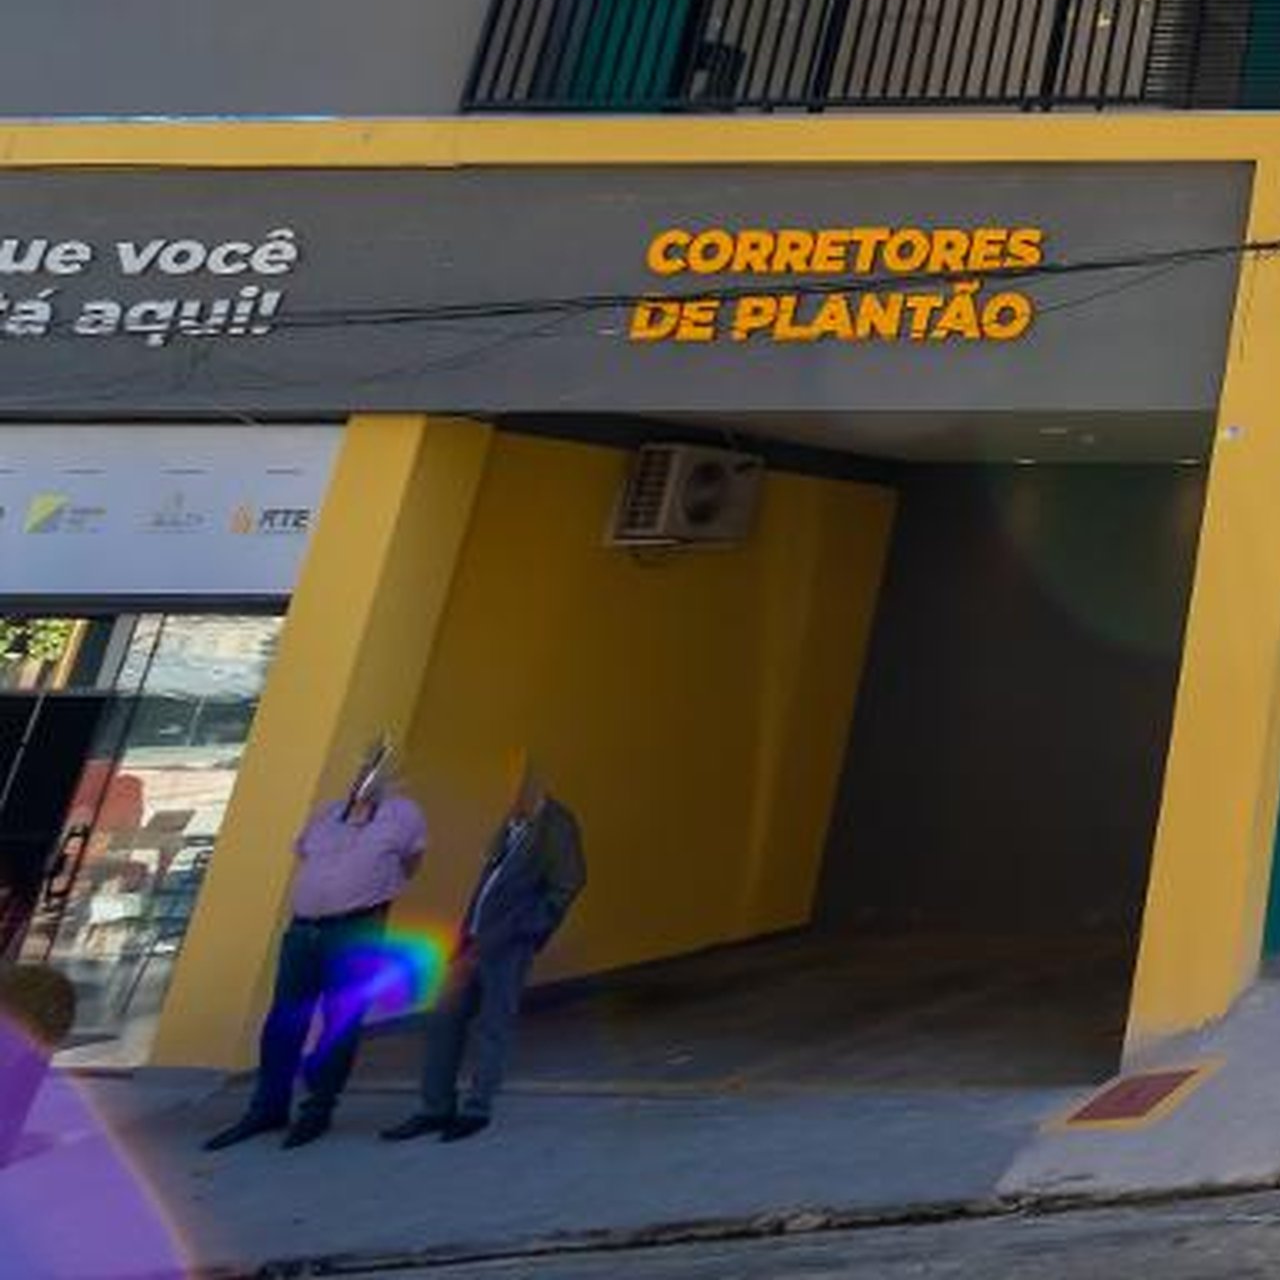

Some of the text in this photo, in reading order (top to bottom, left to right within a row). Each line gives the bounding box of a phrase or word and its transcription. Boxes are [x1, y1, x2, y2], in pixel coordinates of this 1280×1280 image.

[116, 228, 298, 275] você
[646, 227, 1042, 274] CORRETORES
[74, 285, 281, 346] aqui!
[628, 280, 1033, 342] DE PLANTÃO
